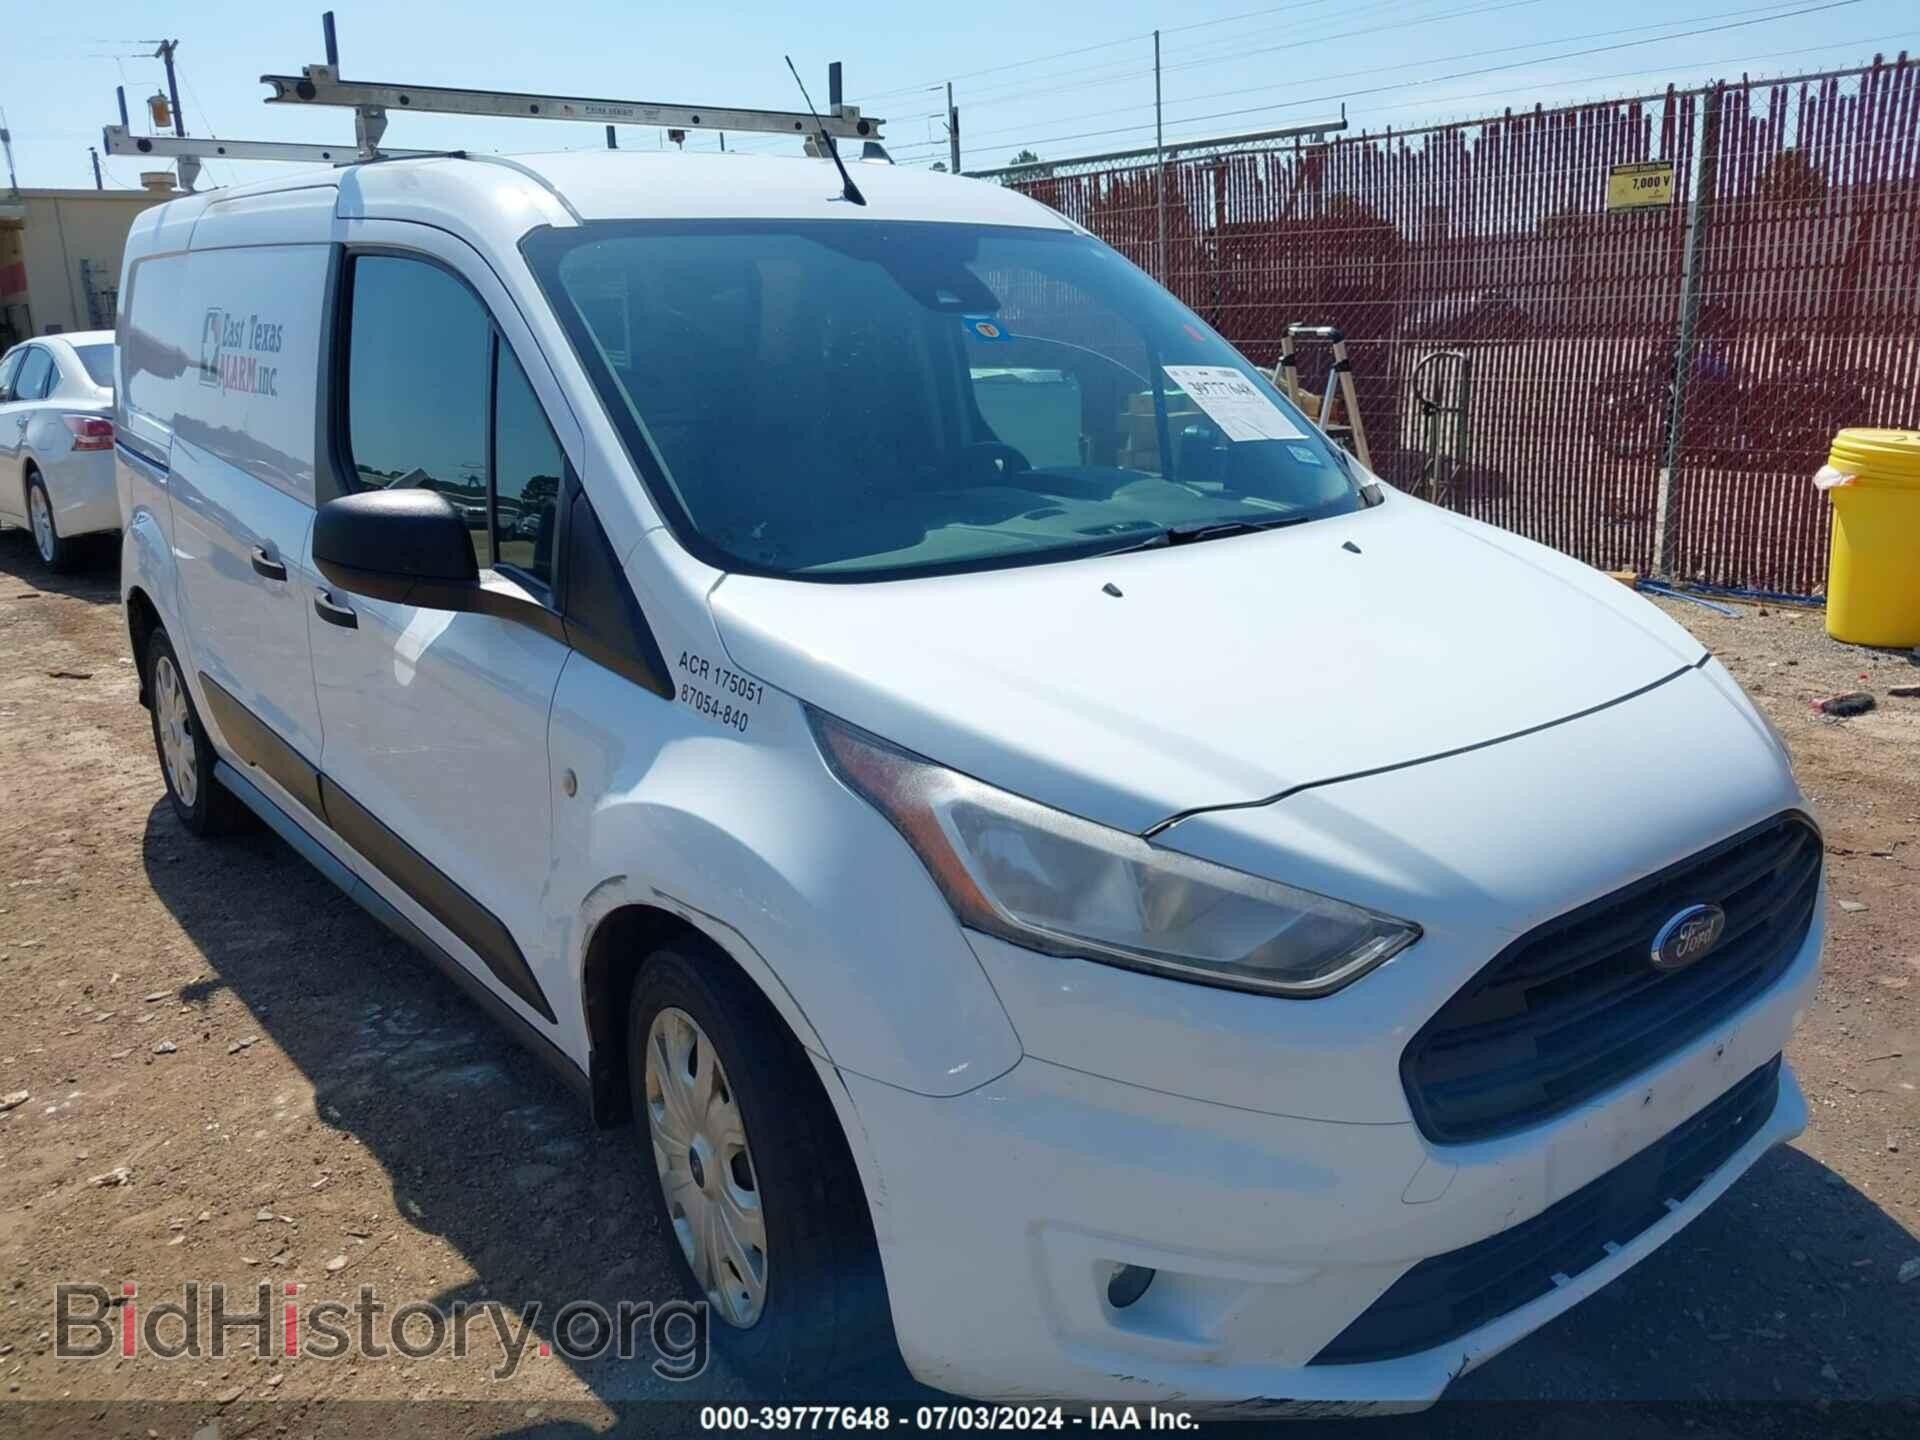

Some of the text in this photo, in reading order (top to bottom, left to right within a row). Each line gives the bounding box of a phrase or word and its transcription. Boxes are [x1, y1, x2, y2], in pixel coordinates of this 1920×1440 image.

[1632, 176, 1670, 191] 7,000 V
[222, 313, 283, 352] East Texas
[679, 651, 764, 705] ACR 175051
[681, 683, 748, 732] 87054-840
[1676, 919, 1714, 958] Ford
